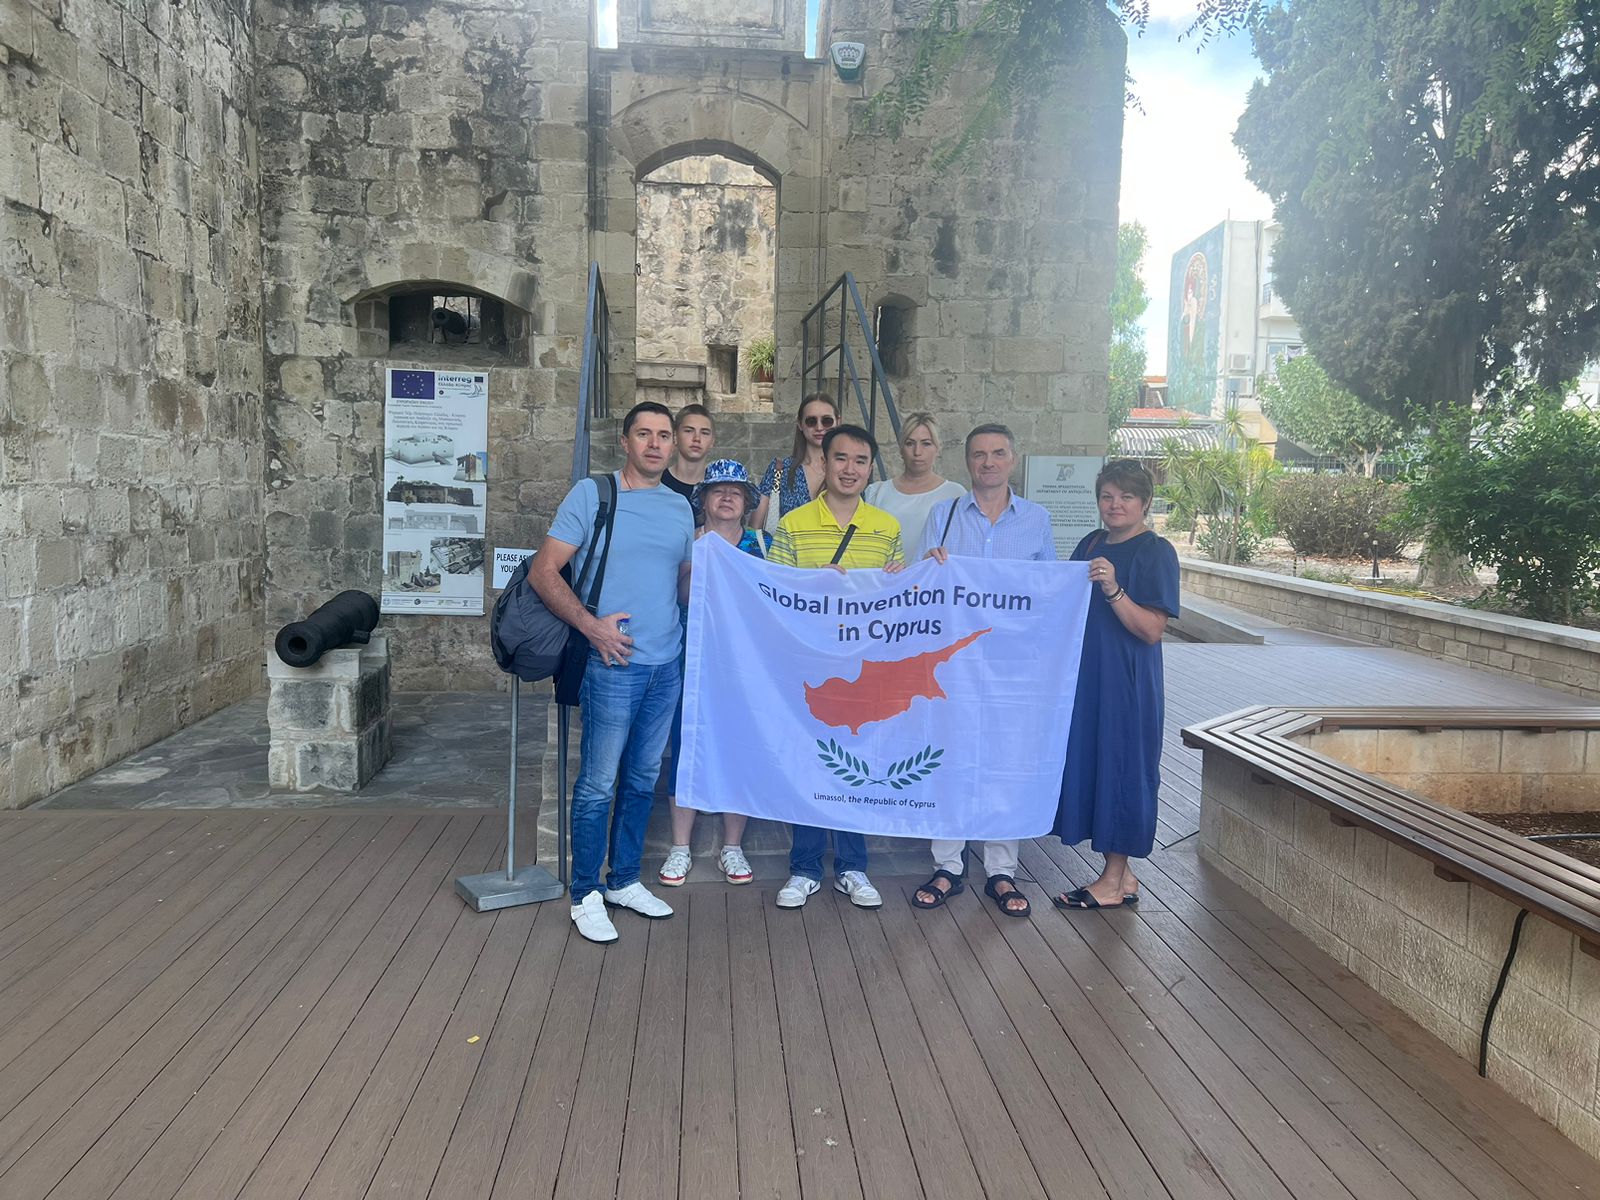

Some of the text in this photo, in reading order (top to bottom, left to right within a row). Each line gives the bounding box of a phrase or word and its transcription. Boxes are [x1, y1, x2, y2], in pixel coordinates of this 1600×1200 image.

[496, 553, 517, 562] PLEASE
[758, 582, 1032, 616] Global Invention Forum
[838, 619, 942, 643] in Cyprus
[813, 792, 936, 809] Limassol, the Republic of Cyprus
